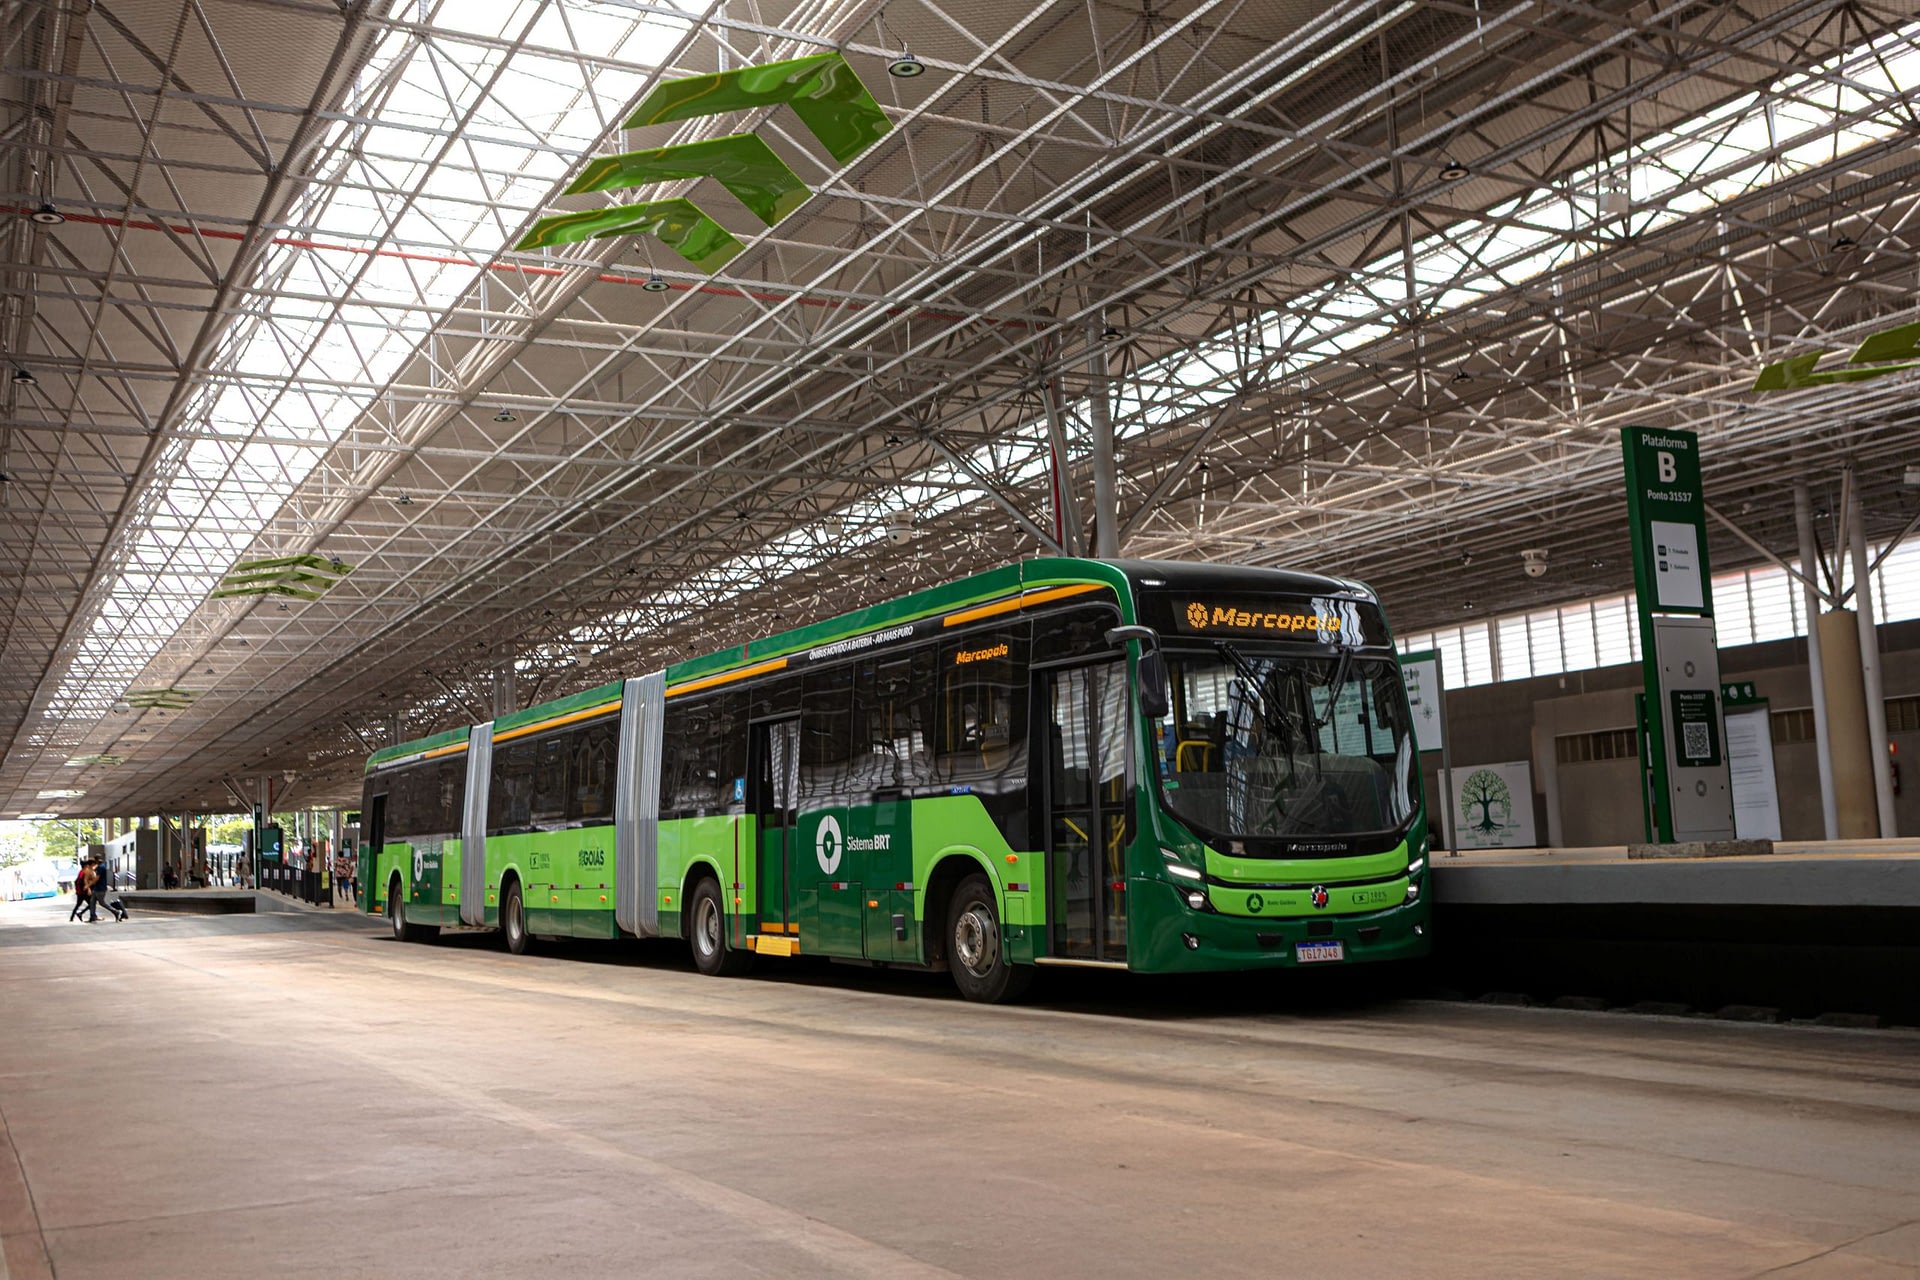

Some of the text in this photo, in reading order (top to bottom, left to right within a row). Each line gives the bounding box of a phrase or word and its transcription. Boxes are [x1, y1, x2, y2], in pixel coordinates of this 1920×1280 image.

[1642, 433, 1688, 449] Plataforma
[1657, 451, 1677, 482] B
[1647, 489, 1692, 502] Ponto 31537
[1211, 607, 1341, 632] Marcopolo
[809, 649, 827, 660] ÔNIBUS
[827, 643, 848, 656] MOVIDO
[851, 637, 873, 650] BATERIA
[875, 633, 883, 645] AR
[883, 630, 897, 642] MAIS
[897, 626, 914, 638] PURO
[956, 643, 1009, 665] Marcopolo
[847, 834, 891, 851] Sistema BRT
[583, 847, 605, 866] GOIÁS
